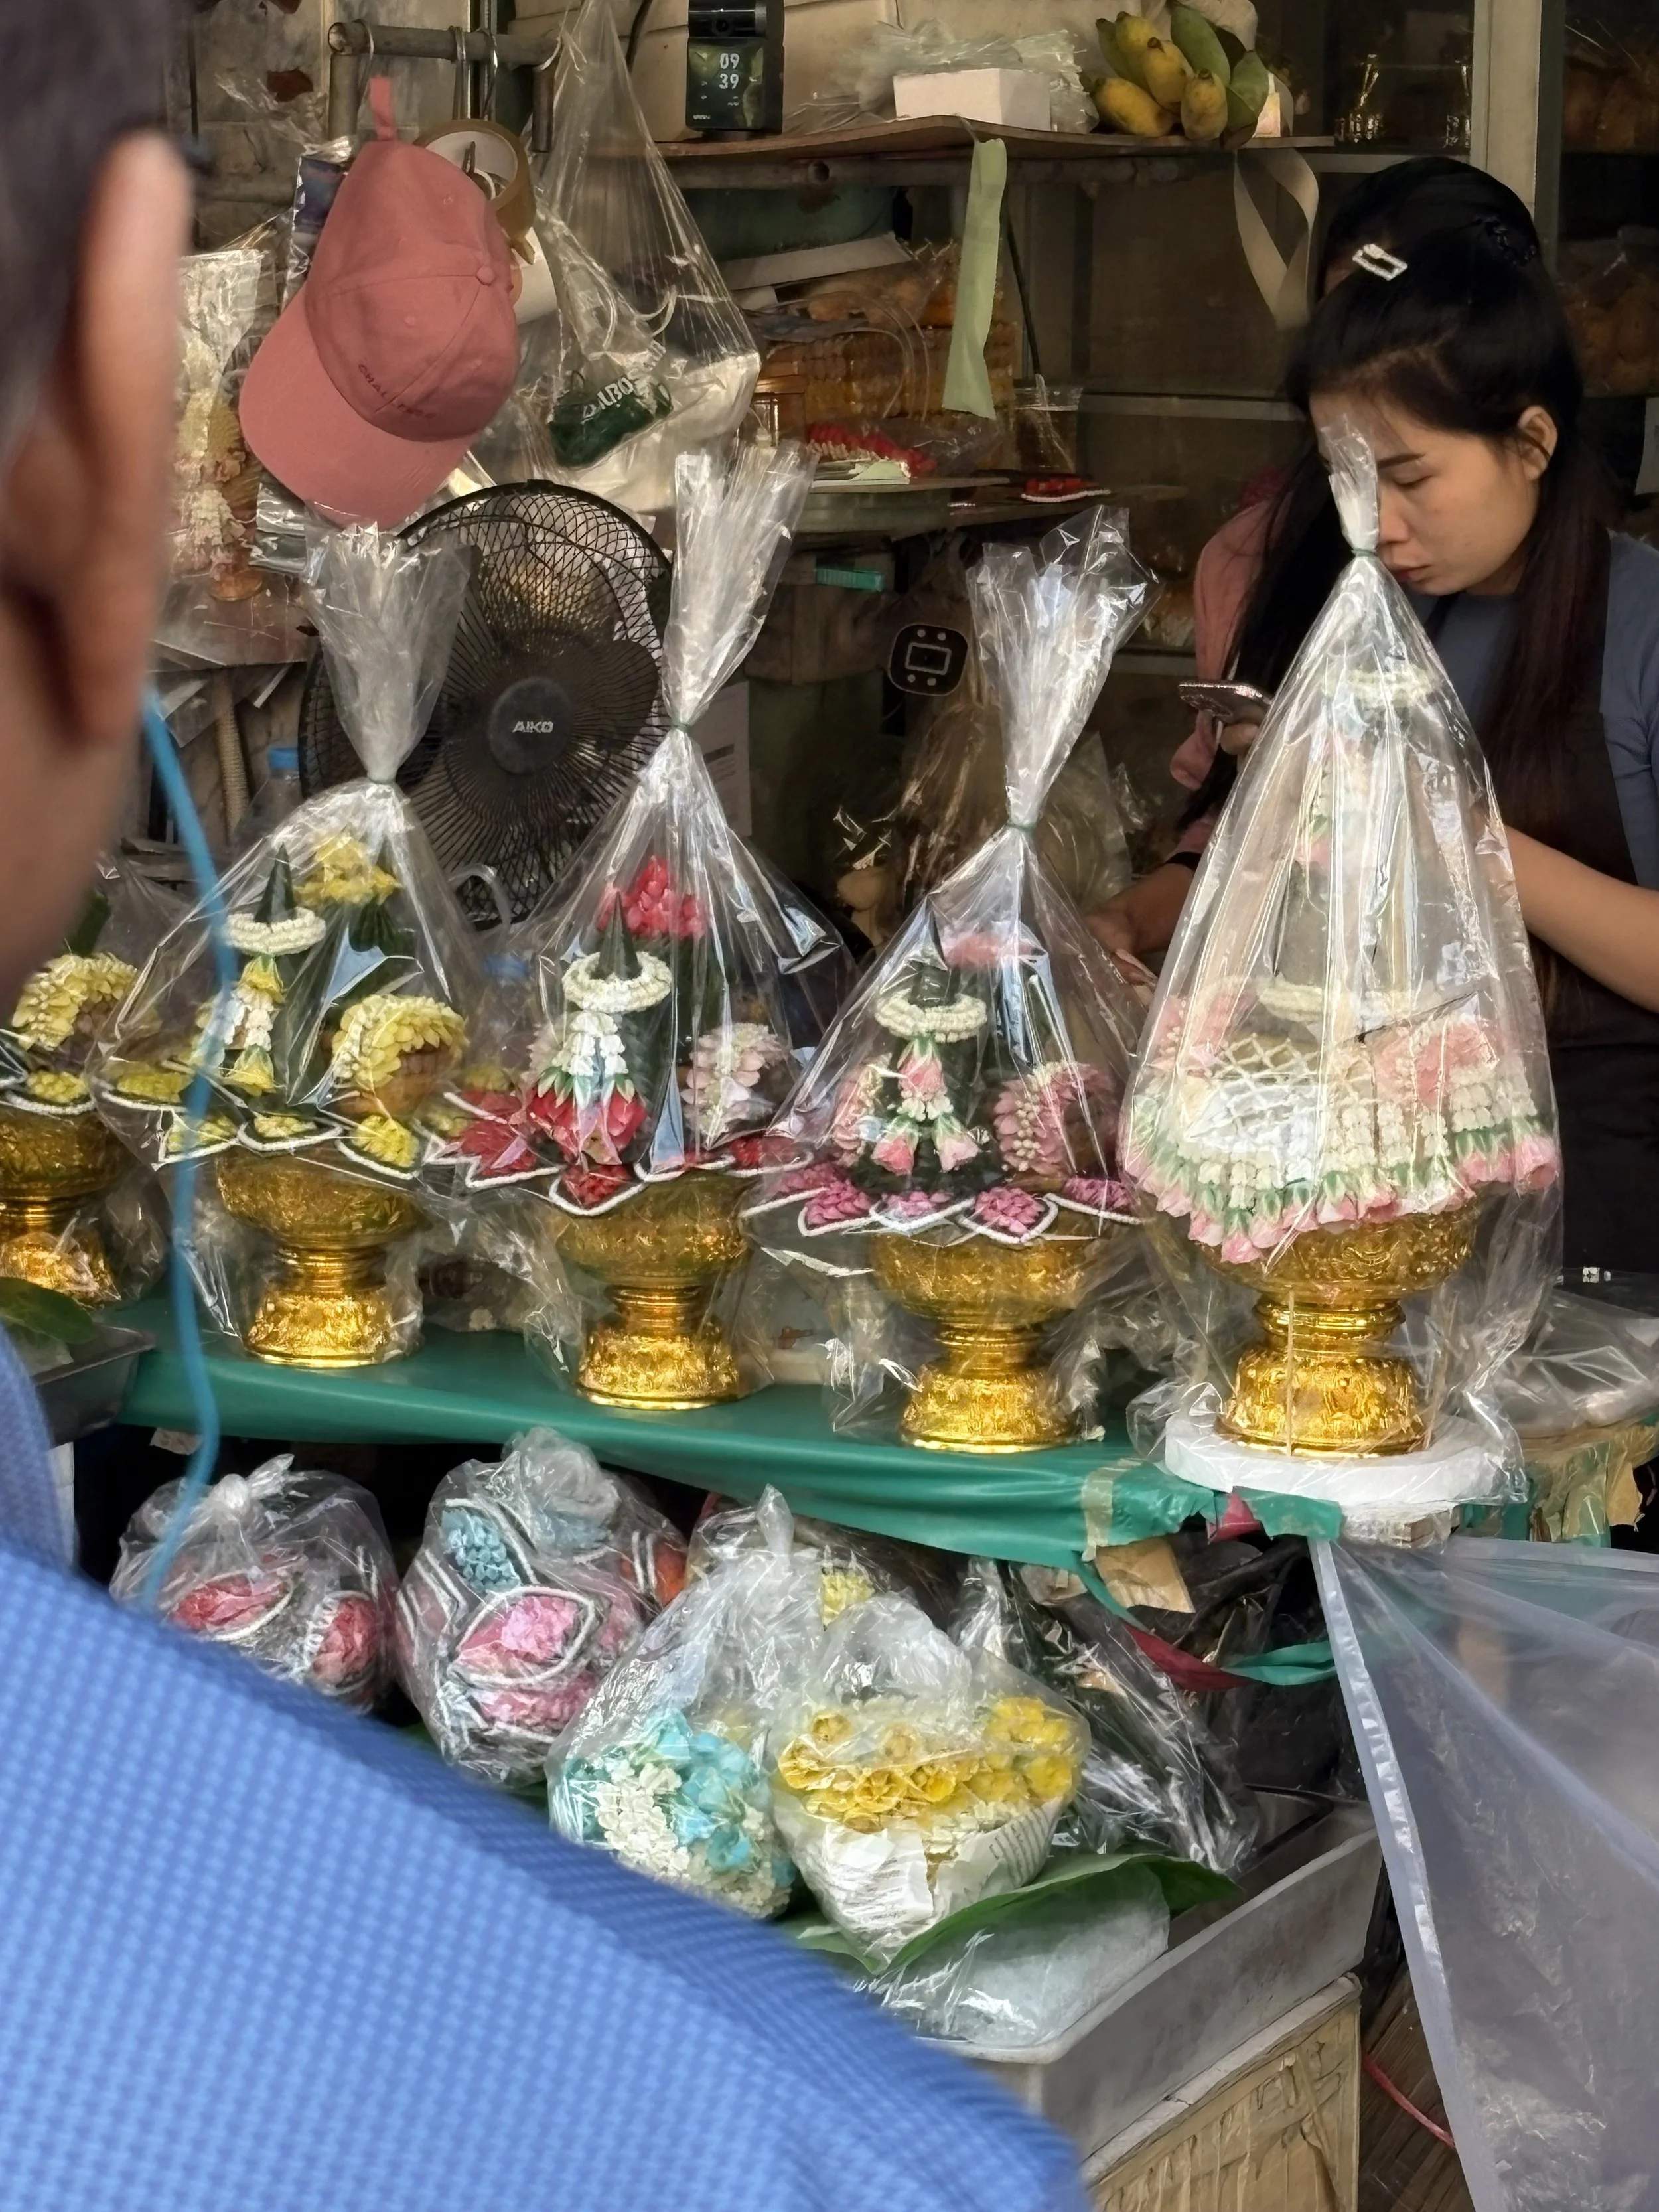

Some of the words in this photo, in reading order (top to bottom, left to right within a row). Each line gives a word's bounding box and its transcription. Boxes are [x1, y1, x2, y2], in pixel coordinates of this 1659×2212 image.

[719, 52, 740, 69] 09
[719, 73, 739, 89] 39
[512, 720, 554, 733] AIKO
